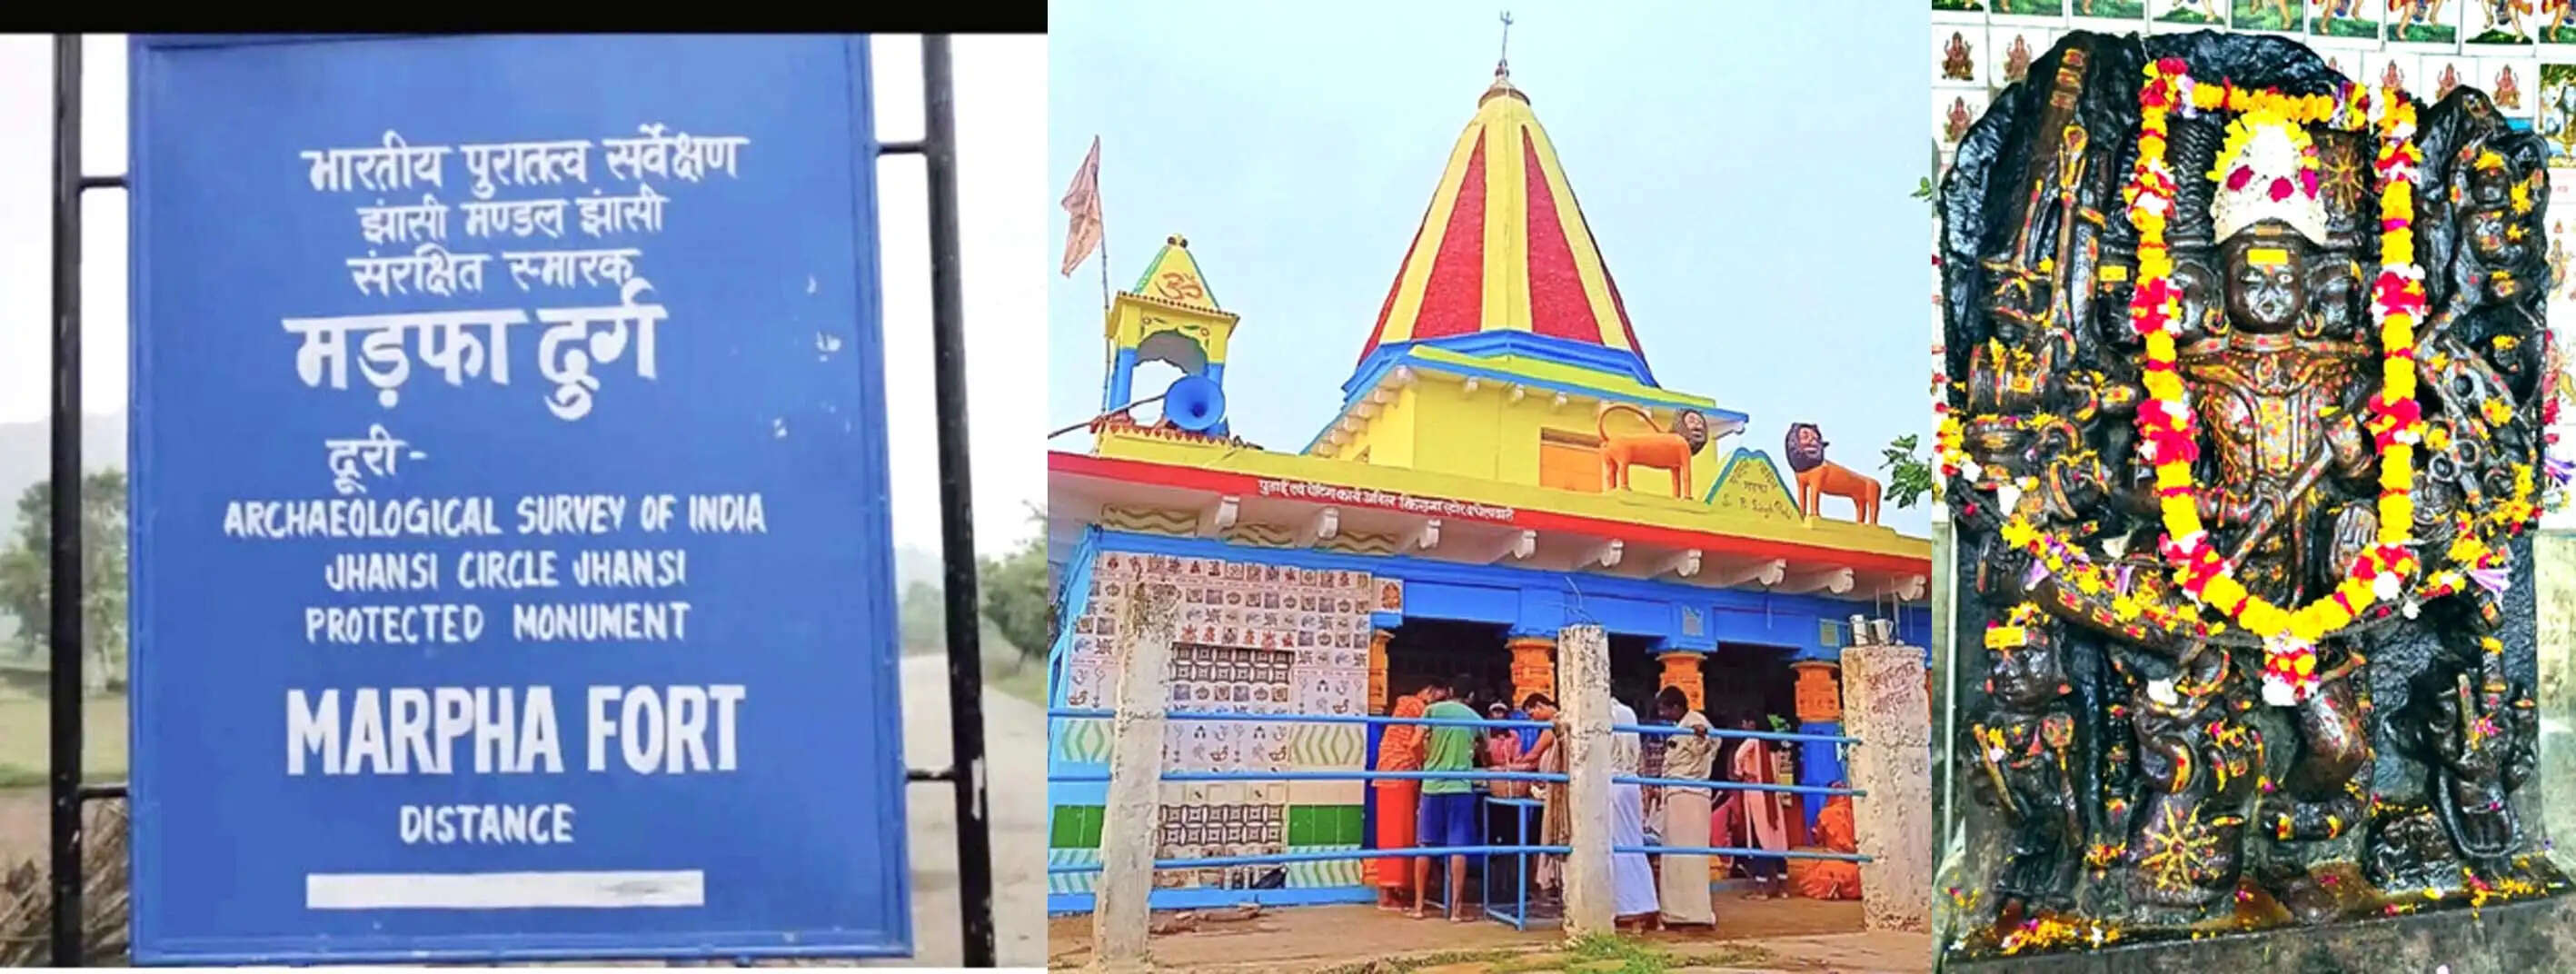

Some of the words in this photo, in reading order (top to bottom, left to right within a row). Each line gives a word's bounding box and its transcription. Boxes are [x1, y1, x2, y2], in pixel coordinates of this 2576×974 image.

[301, 130, 453, 191] भारतीय
[460, 138, 594, 200] पुरातत्व
[602, 124, 751, 182] सर्वेक्षण
[356, 193, 450, 244] झांसी
[460, 198, 570, 238] मण्डल
[575, 182, 670, 237] झांसी
[346, 243, 492, 296] संरक्षित
[502, 248, 642, 290] स्मारक
[283, 309, 529, 407] मड़फा
[536, 276, 669, 420] दुर्ग
[224, 497, 502, 538] ARCHAEOLOGICAL
[517, 493, 626, 535] SURVEY
[641, 493, 677, 532] OF
[690, 492, 767, 533] INDIA
[326, 552, 438, 591] JHANSI
[458, 550, 559, 589] CIRCLE
[573, 549, 685, 587] JHANSI
[306, 604, 483, 643] PROTECTED
[513, 601, 691, 641] MONUMENT
[287, 686, 563, 775] MARPHA
[588, 684, 746, 774] FORT
[401, 804, 574, 844] DISTANCE
